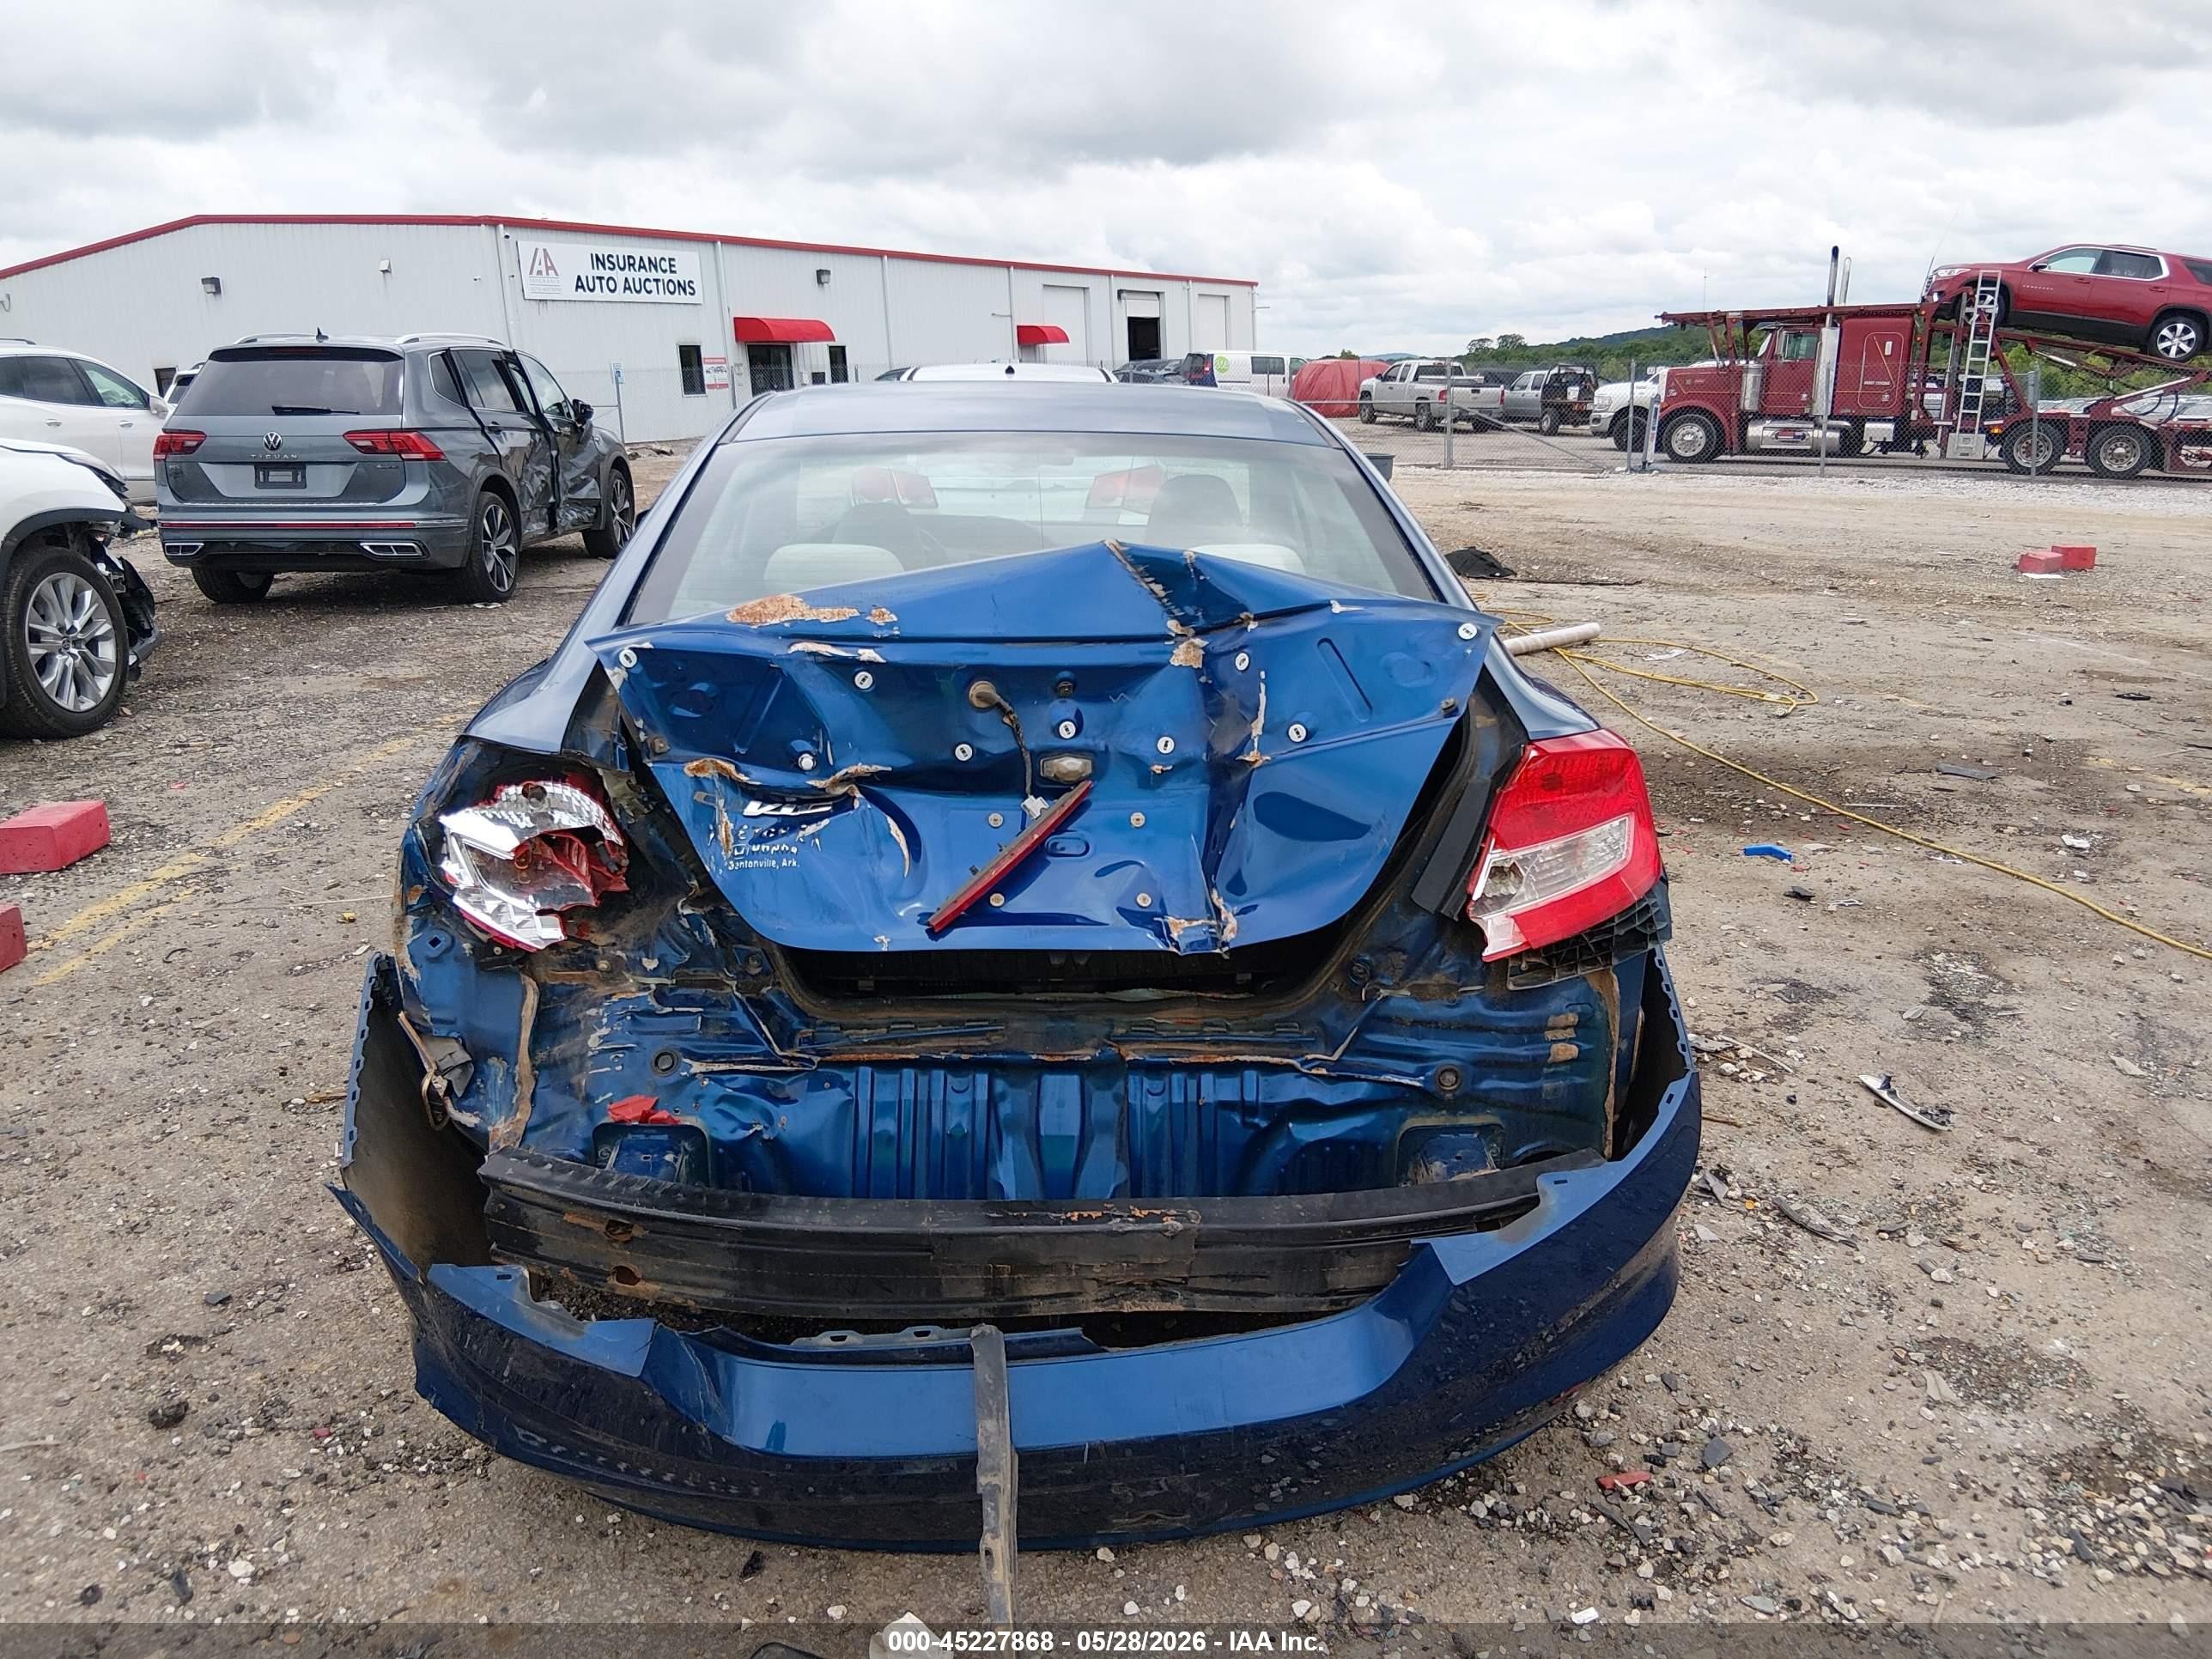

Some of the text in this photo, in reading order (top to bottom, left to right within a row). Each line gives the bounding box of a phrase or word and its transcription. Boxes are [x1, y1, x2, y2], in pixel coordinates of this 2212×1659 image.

[590, 252, 678, 274] INSURANCE
[574, 274, 696, 296] AUTO AUCTIONS
[781, 857, 800, 868] Ark.
